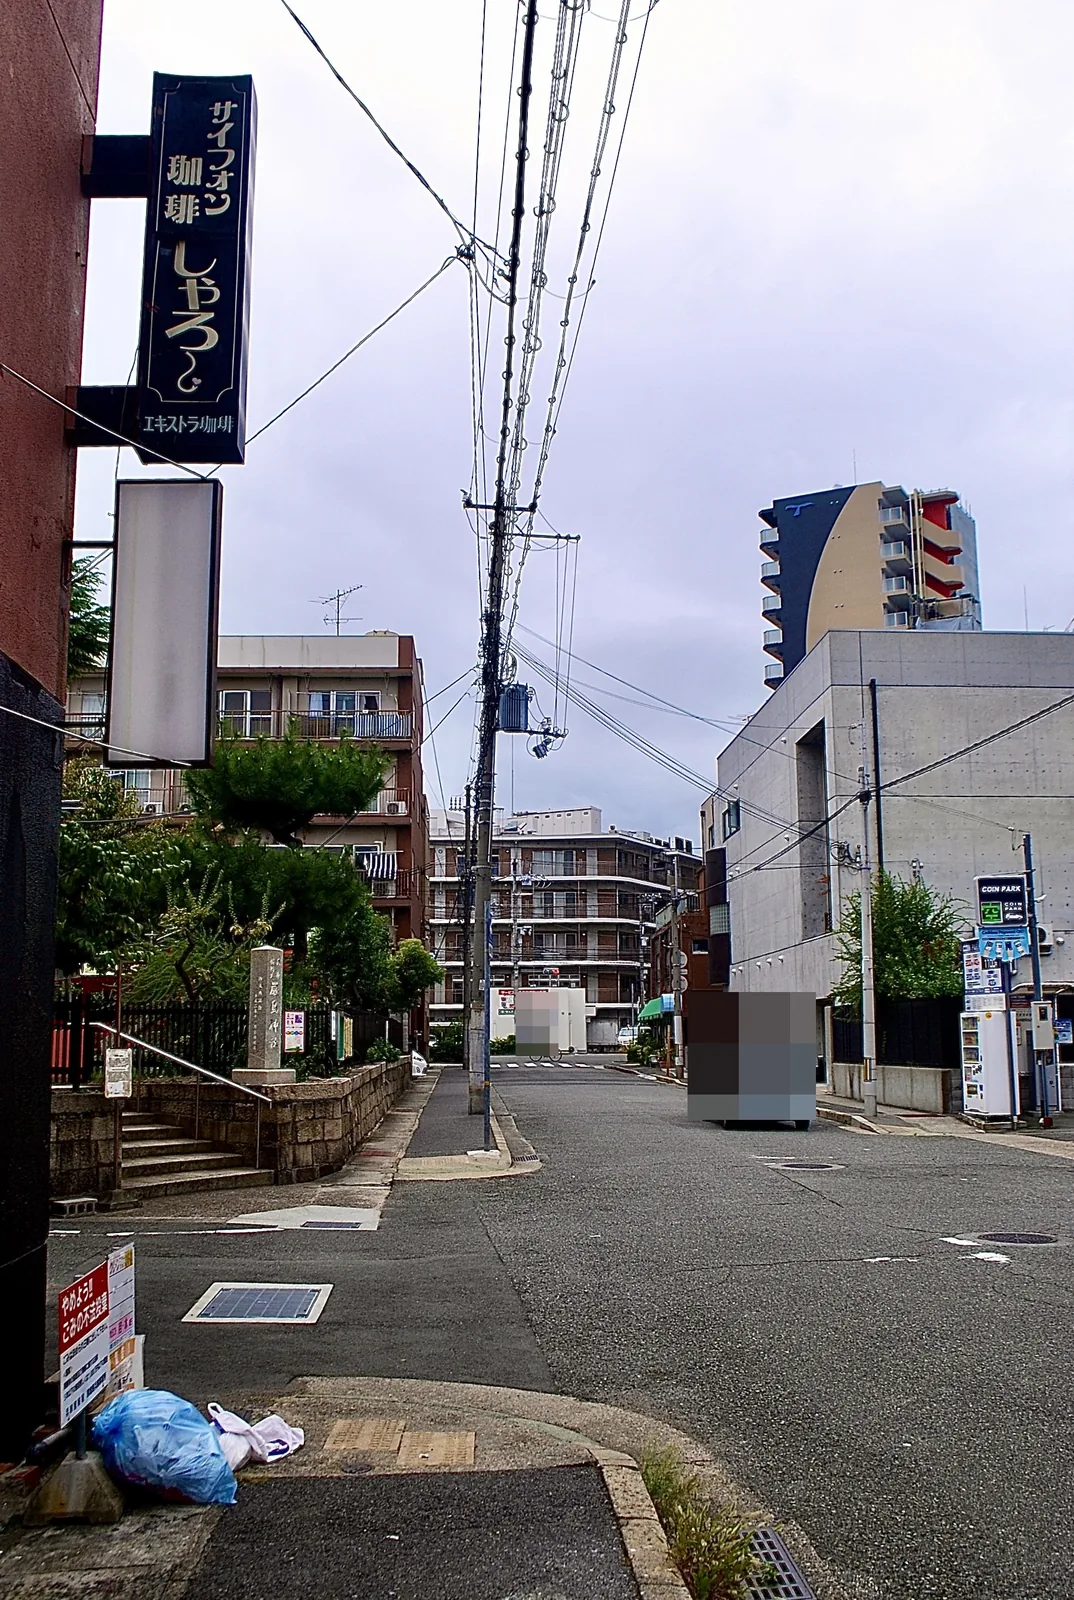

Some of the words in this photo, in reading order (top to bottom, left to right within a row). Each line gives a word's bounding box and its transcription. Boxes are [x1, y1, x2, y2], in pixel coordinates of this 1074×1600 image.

[164, 155, 203, 224] 珈琲
[143, 415, 235, 433] エキストラ珈琲
